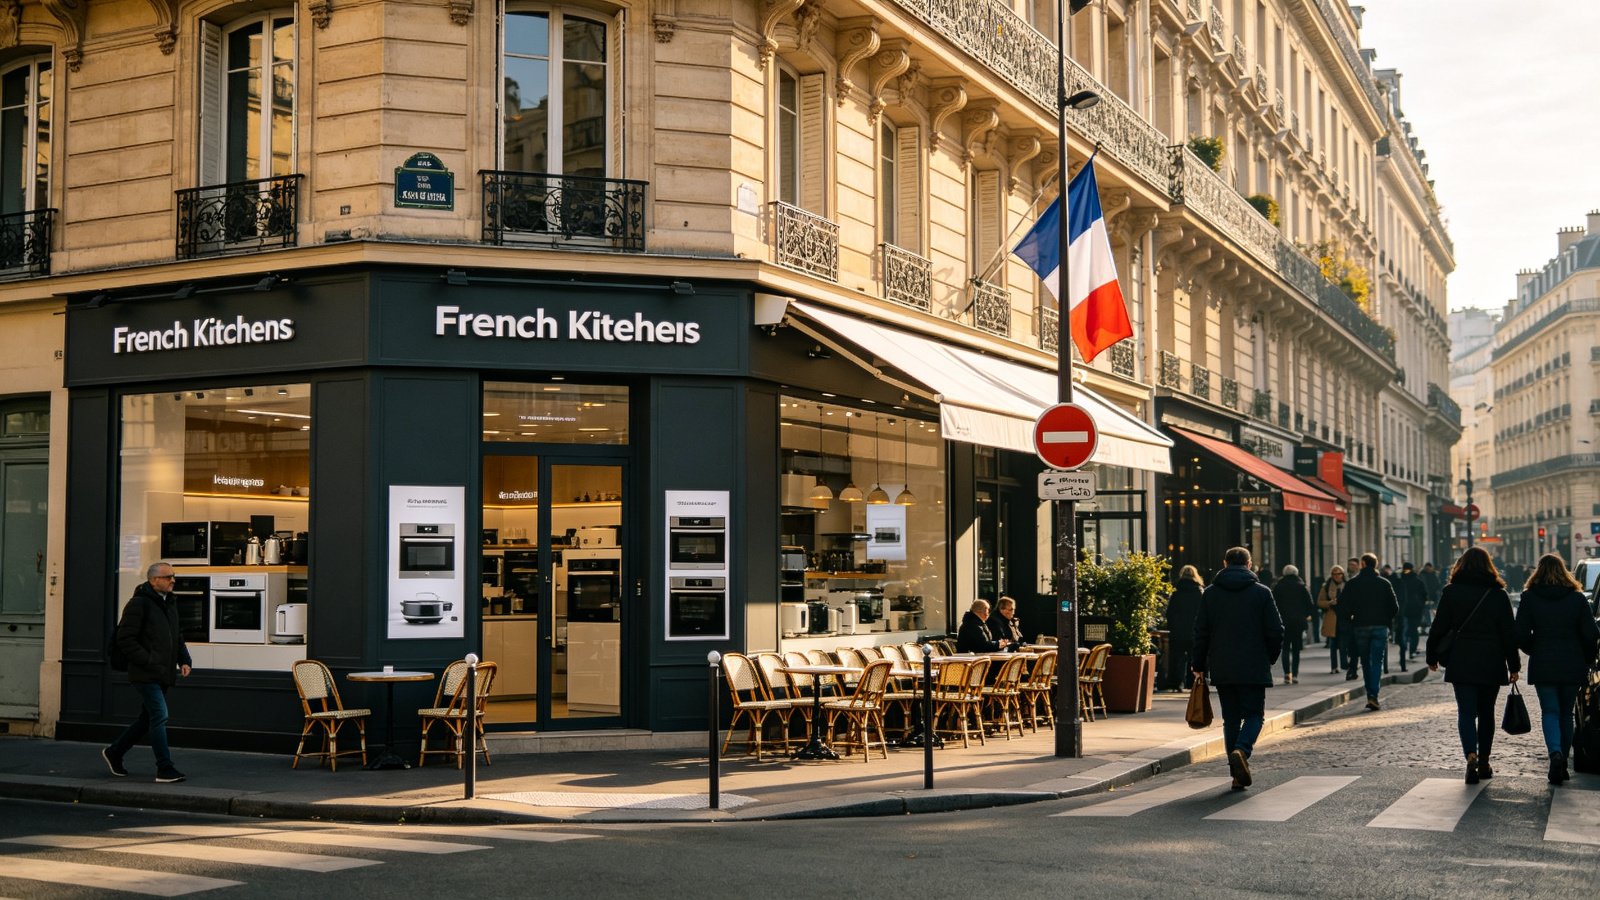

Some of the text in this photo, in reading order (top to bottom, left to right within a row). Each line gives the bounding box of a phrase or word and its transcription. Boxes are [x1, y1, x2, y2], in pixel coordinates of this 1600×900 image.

[114, 315, 295, 353] French Kitchens
[435, 305, 558, 339] French
